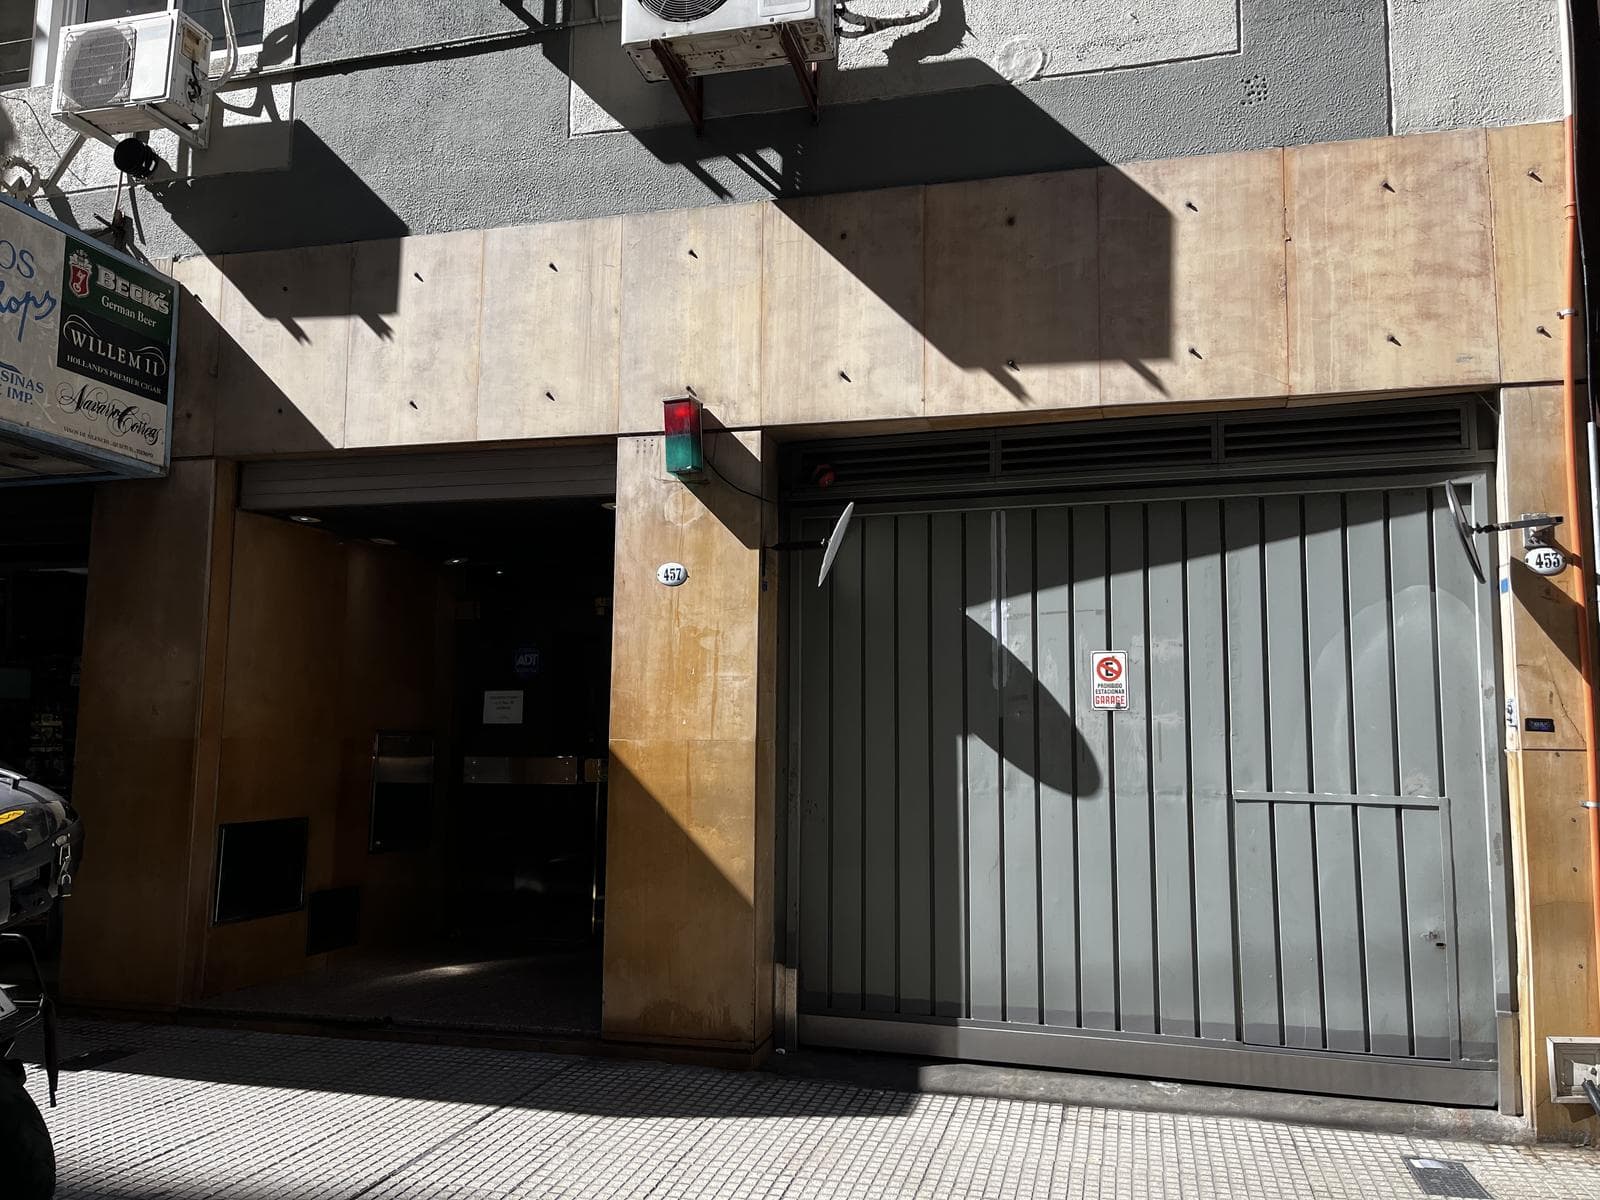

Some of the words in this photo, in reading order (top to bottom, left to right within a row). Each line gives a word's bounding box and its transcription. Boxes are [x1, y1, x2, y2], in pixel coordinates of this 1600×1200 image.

[101, 295, 136, 319] German
[137, 311, 157, 328] Beer
[71, 328, 141, 369] WILLEM
[145, 358, 159, 377] II
[109, 370, 140, 386] PREMIER
[140, 382, 162, 394] CIGAR
[7, 387, 33, 405] IMP.
[57, 383, 120, 421] Navarro
[113, 403, 161, 445] Correas
[1535, 553, 1560, 569] 453
[663, 567, 682, 581] 457
[516, 653, 538, 666] ADT
[1095, 695, 1125, 705] GARAGE
